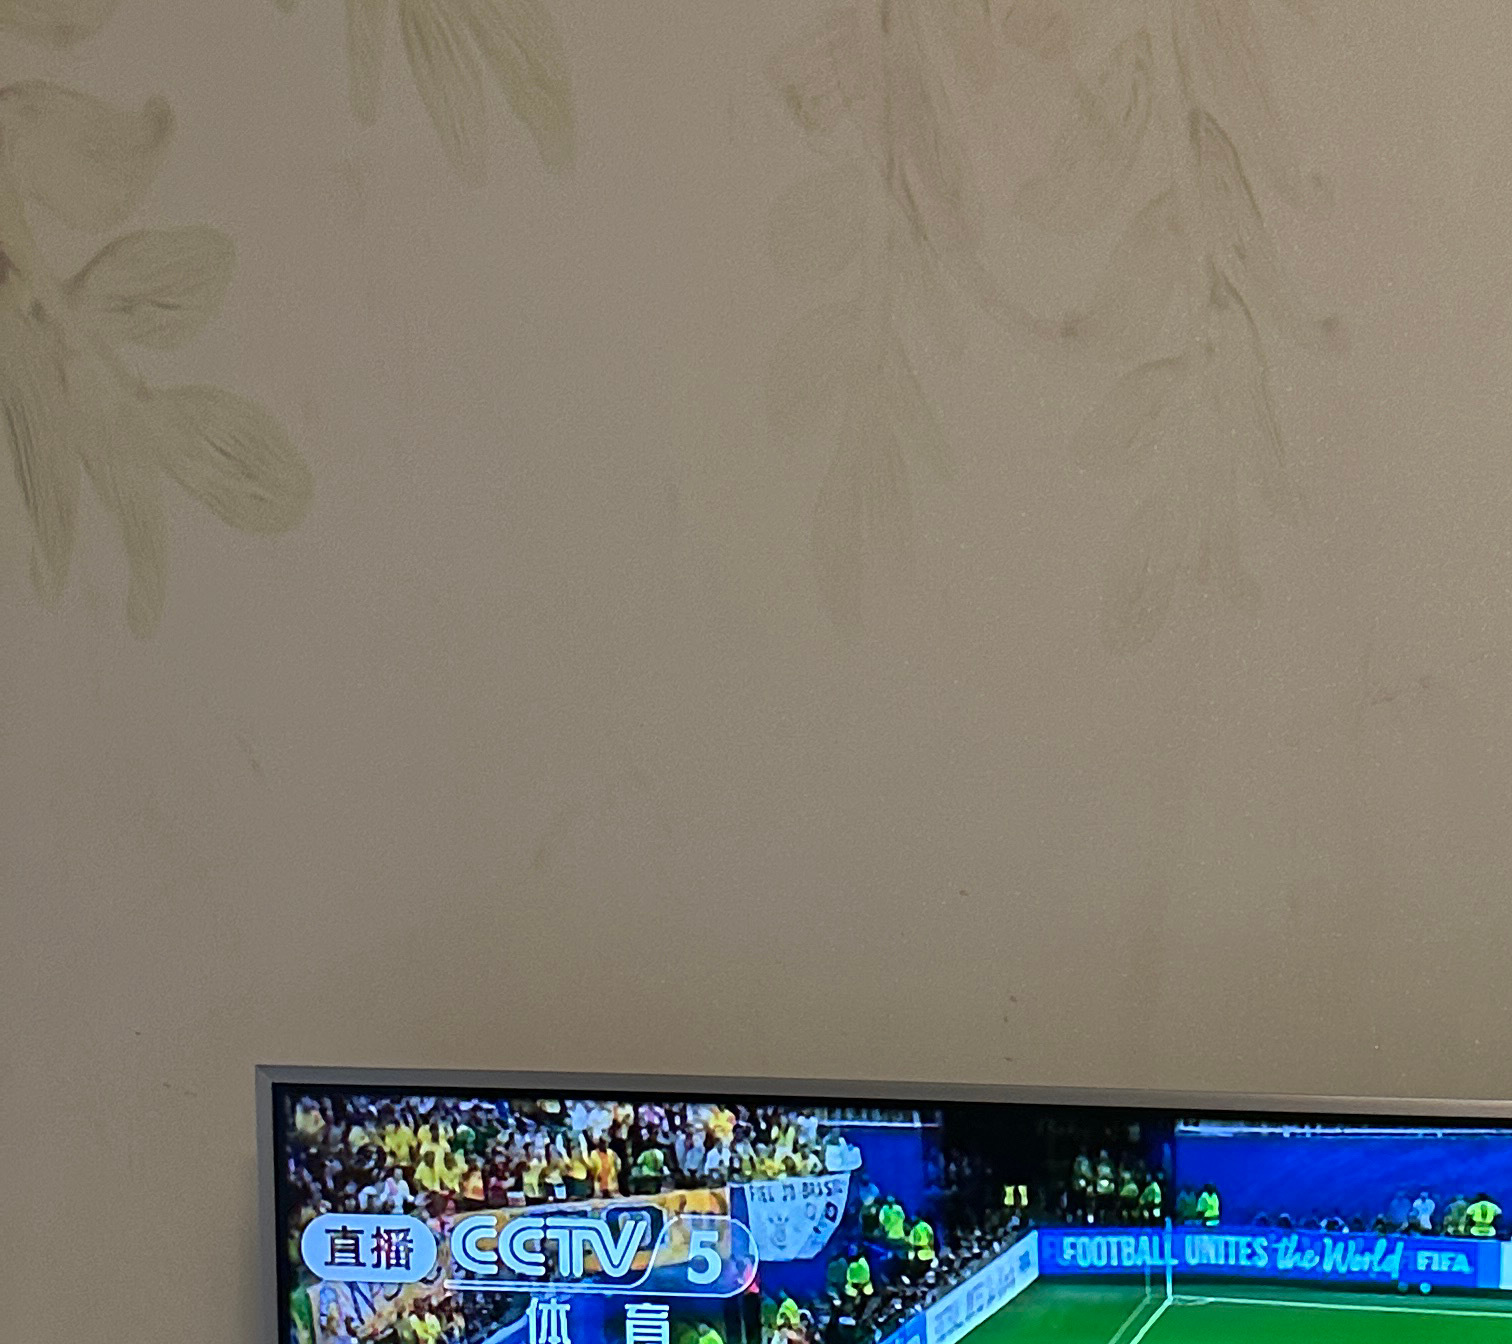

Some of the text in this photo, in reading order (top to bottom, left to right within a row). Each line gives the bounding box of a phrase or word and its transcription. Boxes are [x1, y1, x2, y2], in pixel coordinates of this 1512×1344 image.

[324, 1225, 415, 1271] 直播
[450, 1215, 723, 1285] CCTV 5
[1061, 1234, 1178, 1267] FOOTBALL
[1184, 1235, 1269, 1268] UNITES
[1271, 1232, 1320, 1271] the
[1416, 1251, 1471, 1274] FIFA
